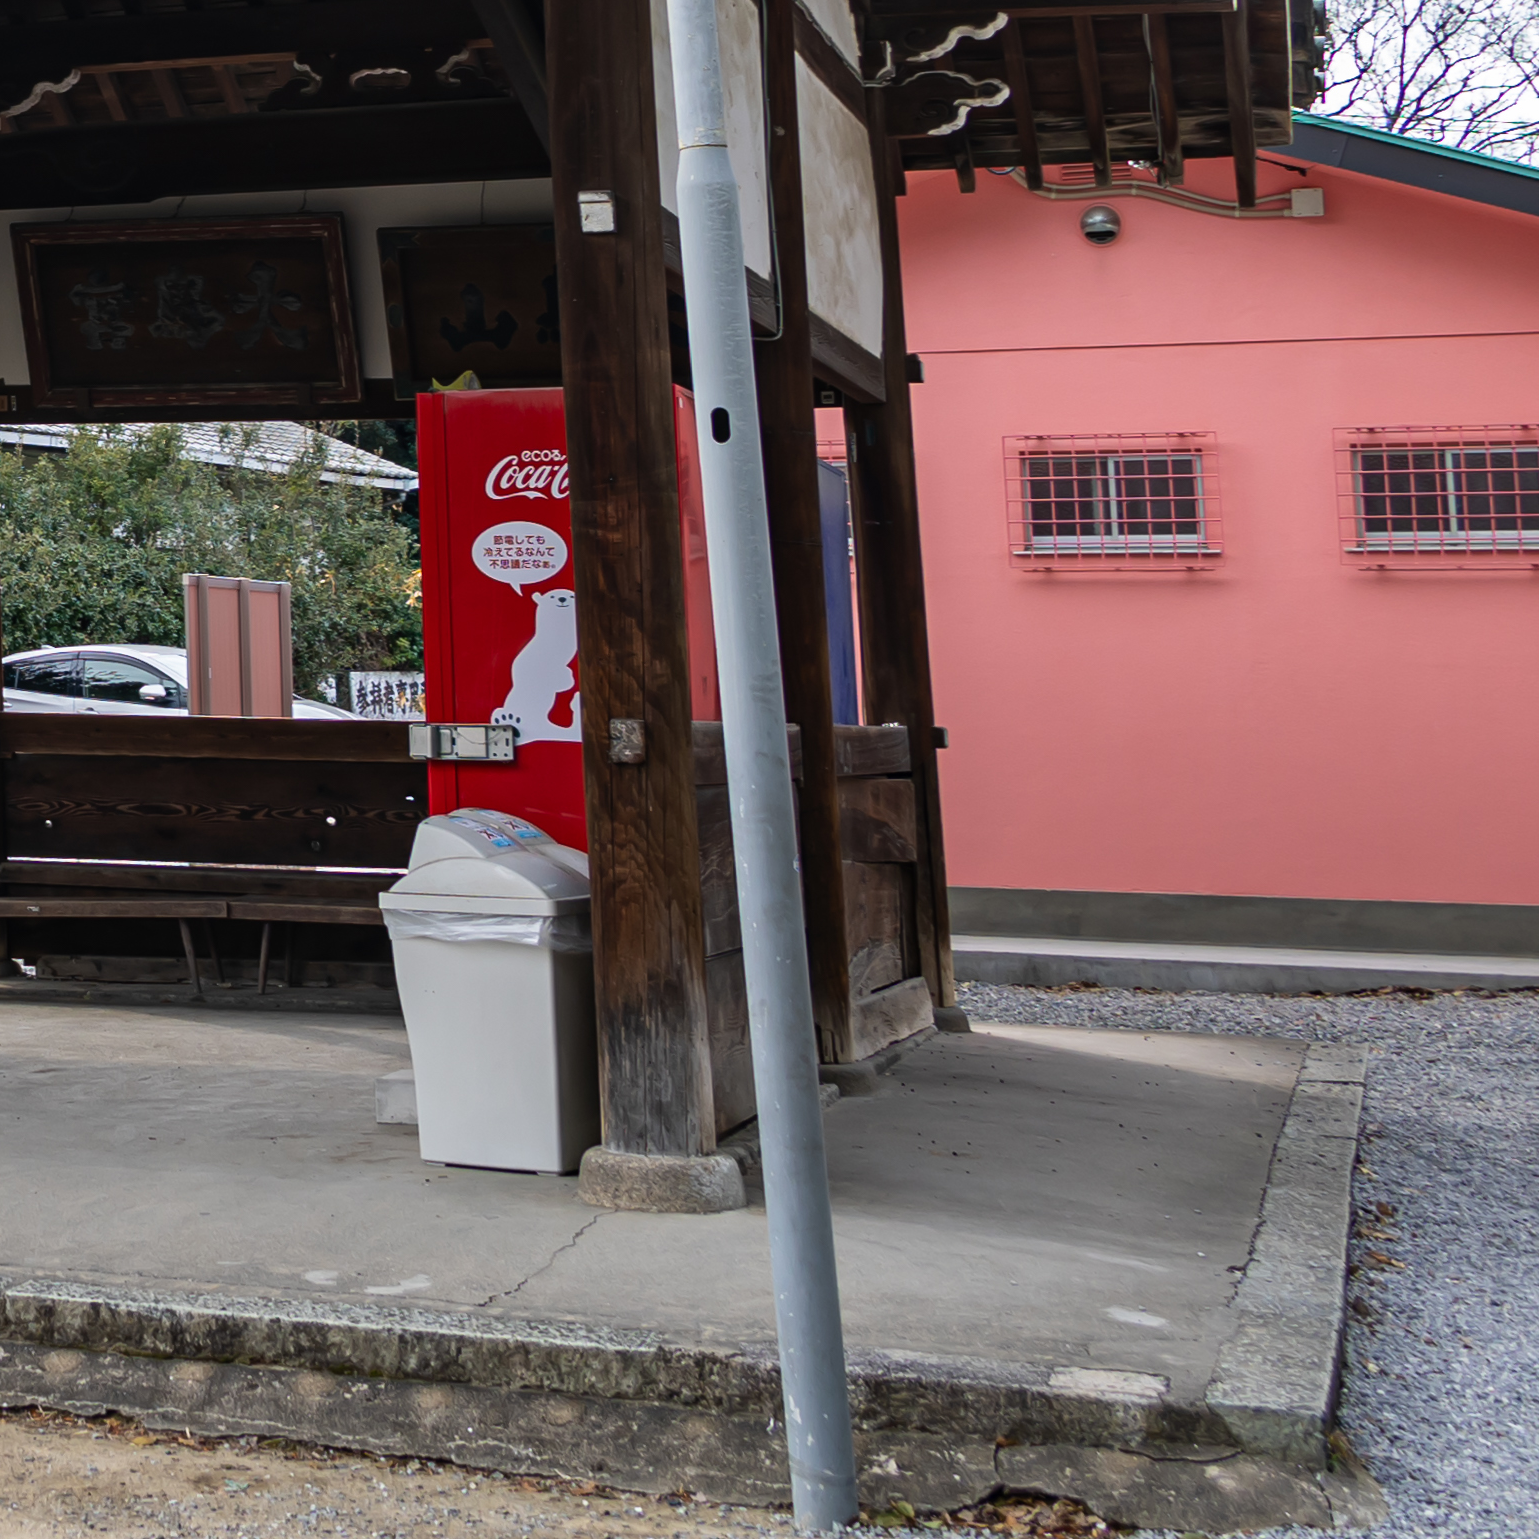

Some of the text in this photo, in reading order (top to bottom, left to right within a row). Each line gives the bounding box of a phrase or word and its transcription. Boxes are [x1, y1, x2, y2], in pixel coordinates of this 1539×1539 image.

[493, 535, 546, 545] 節電しても
[483, 547, 555, 557] 冷えてるなんて
